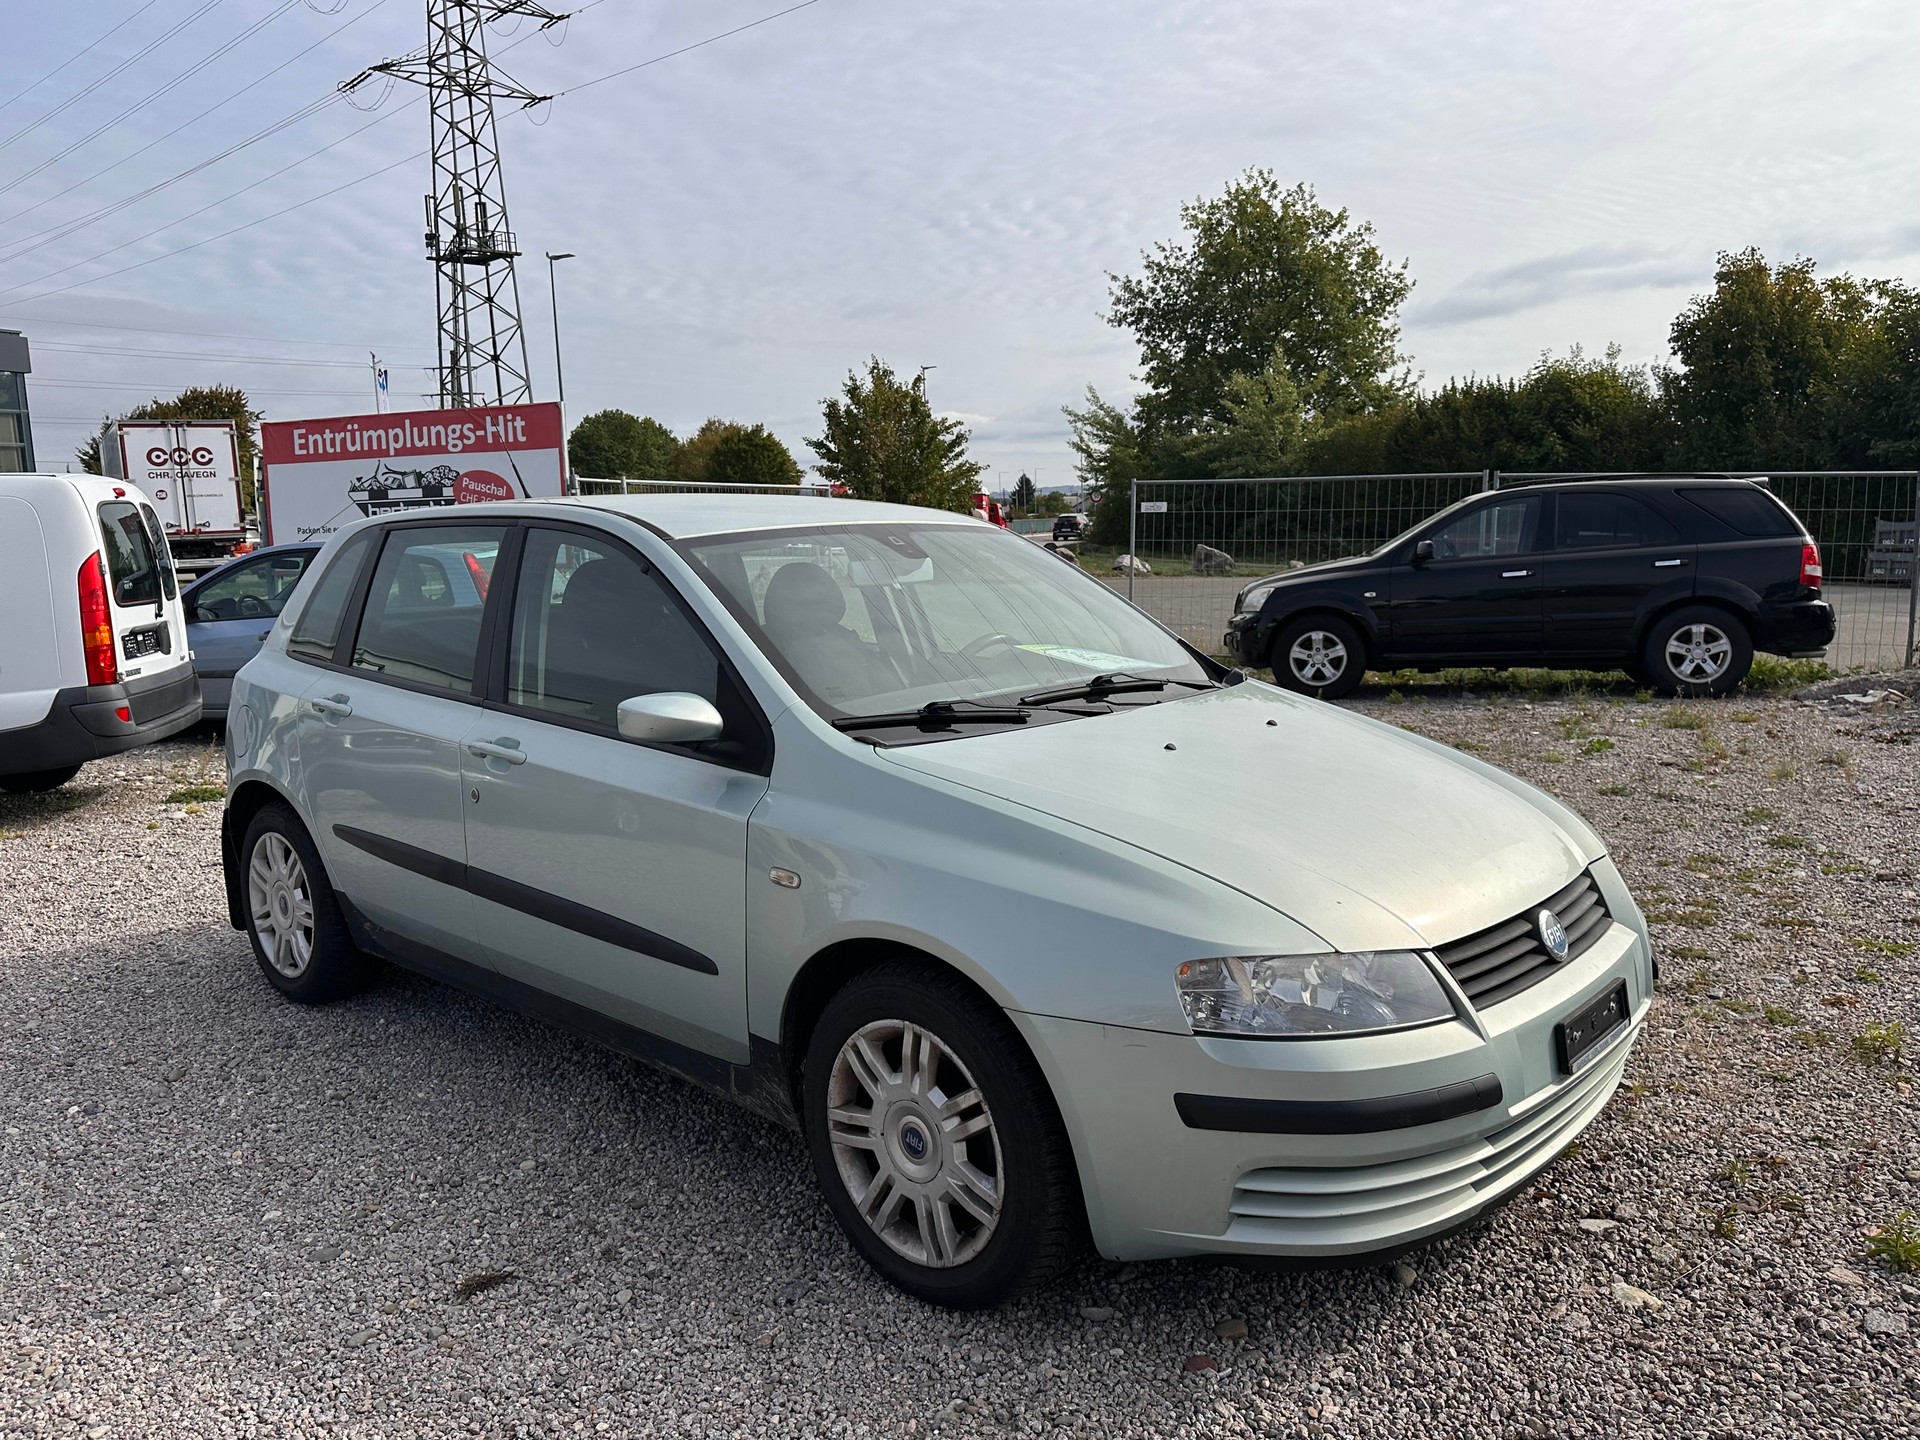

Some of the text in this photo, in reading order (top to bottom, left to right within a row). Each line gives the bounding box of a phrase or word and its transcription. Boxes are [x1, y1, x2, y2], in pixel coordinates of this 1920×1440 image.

[293, 414, 526, 455] Entrümplungs-Hit
[146, 447, 214, 466] CCC
[148, 471, 216, 479] CHR. CAVEGN
[462, 477, 507, 497] Pauschal
[460, 492, 479, 504] CHF
[297, 526, 320, 535] Packen
[321, 526, 332, 534] Sie
[1547, 923, 1565, 945] FIAT
[905, 1132, 923, 1151] FIAT
